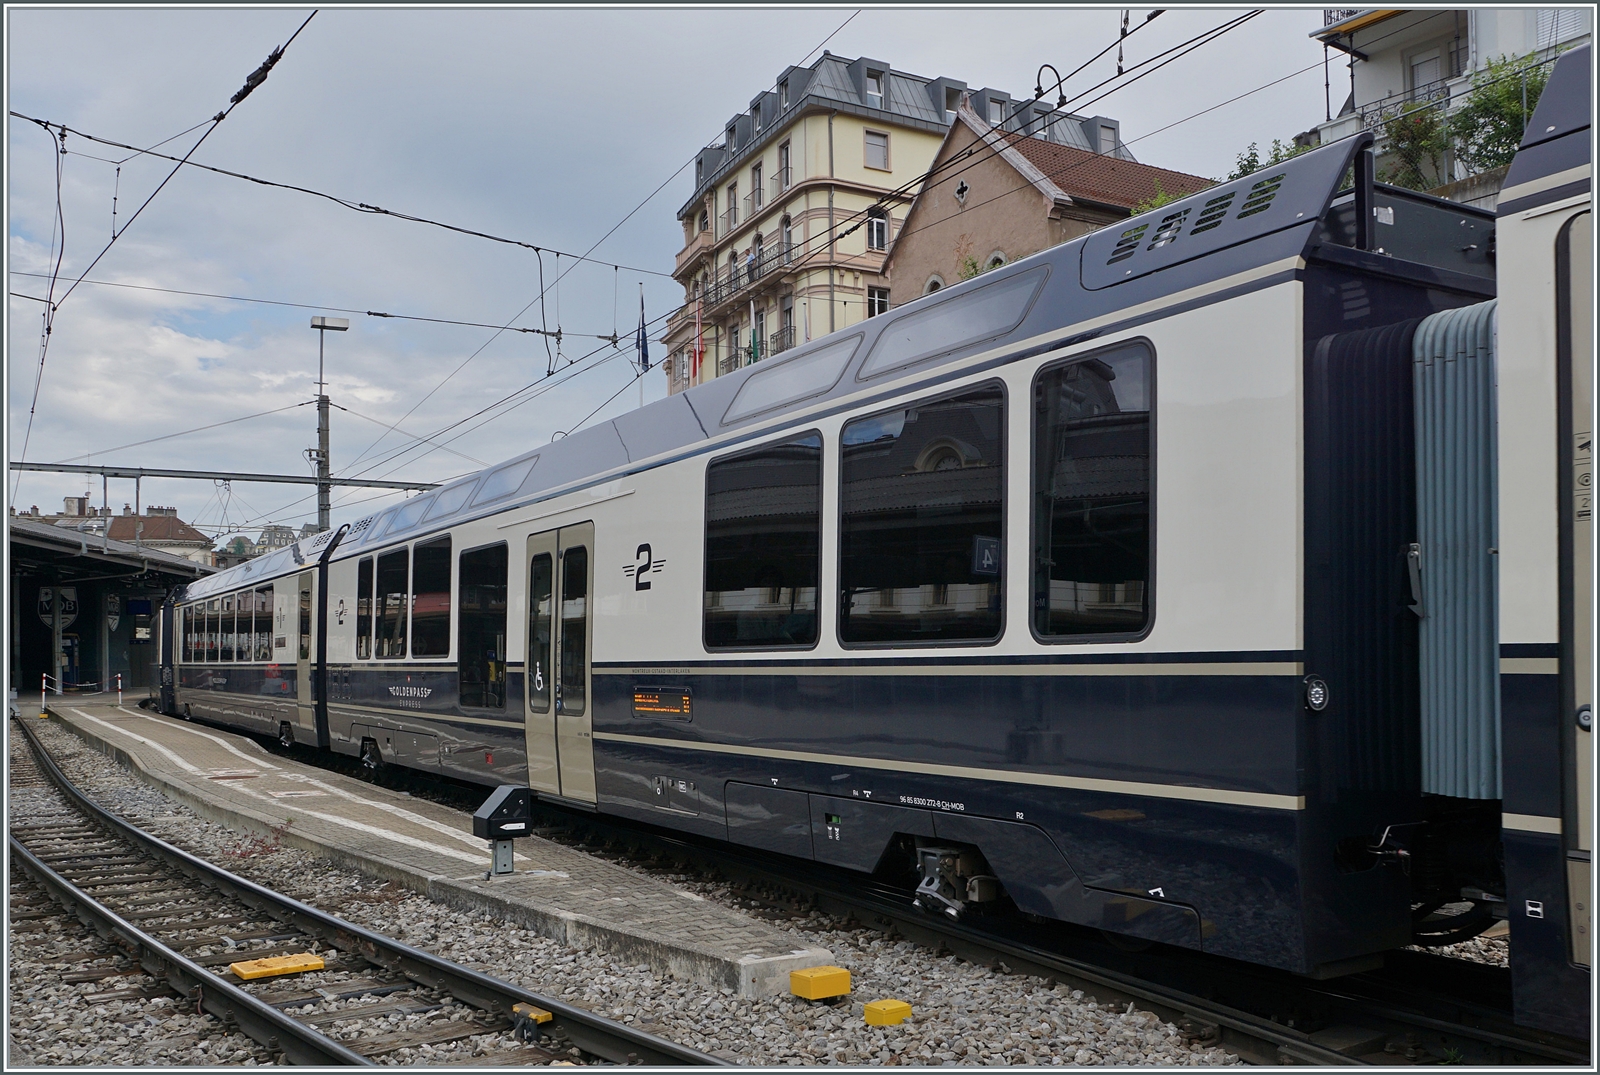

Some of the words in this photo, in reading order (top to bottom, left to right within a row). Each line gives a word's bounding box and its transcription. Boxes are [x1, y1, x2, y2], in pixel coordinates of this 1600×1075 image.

[635, 542, 652, 591] 2
[391, 686, 428, 698] GOLDENPASS
[900, 795, 906, 803] 96
[907, 796, 914, 804] 85
[914, 797, 926, 806] 8300
[927, 798, 941, 808] 272-8
[941, 800, 965, 811] CH-MOB
[1016, 811, 1025, 820] R2
